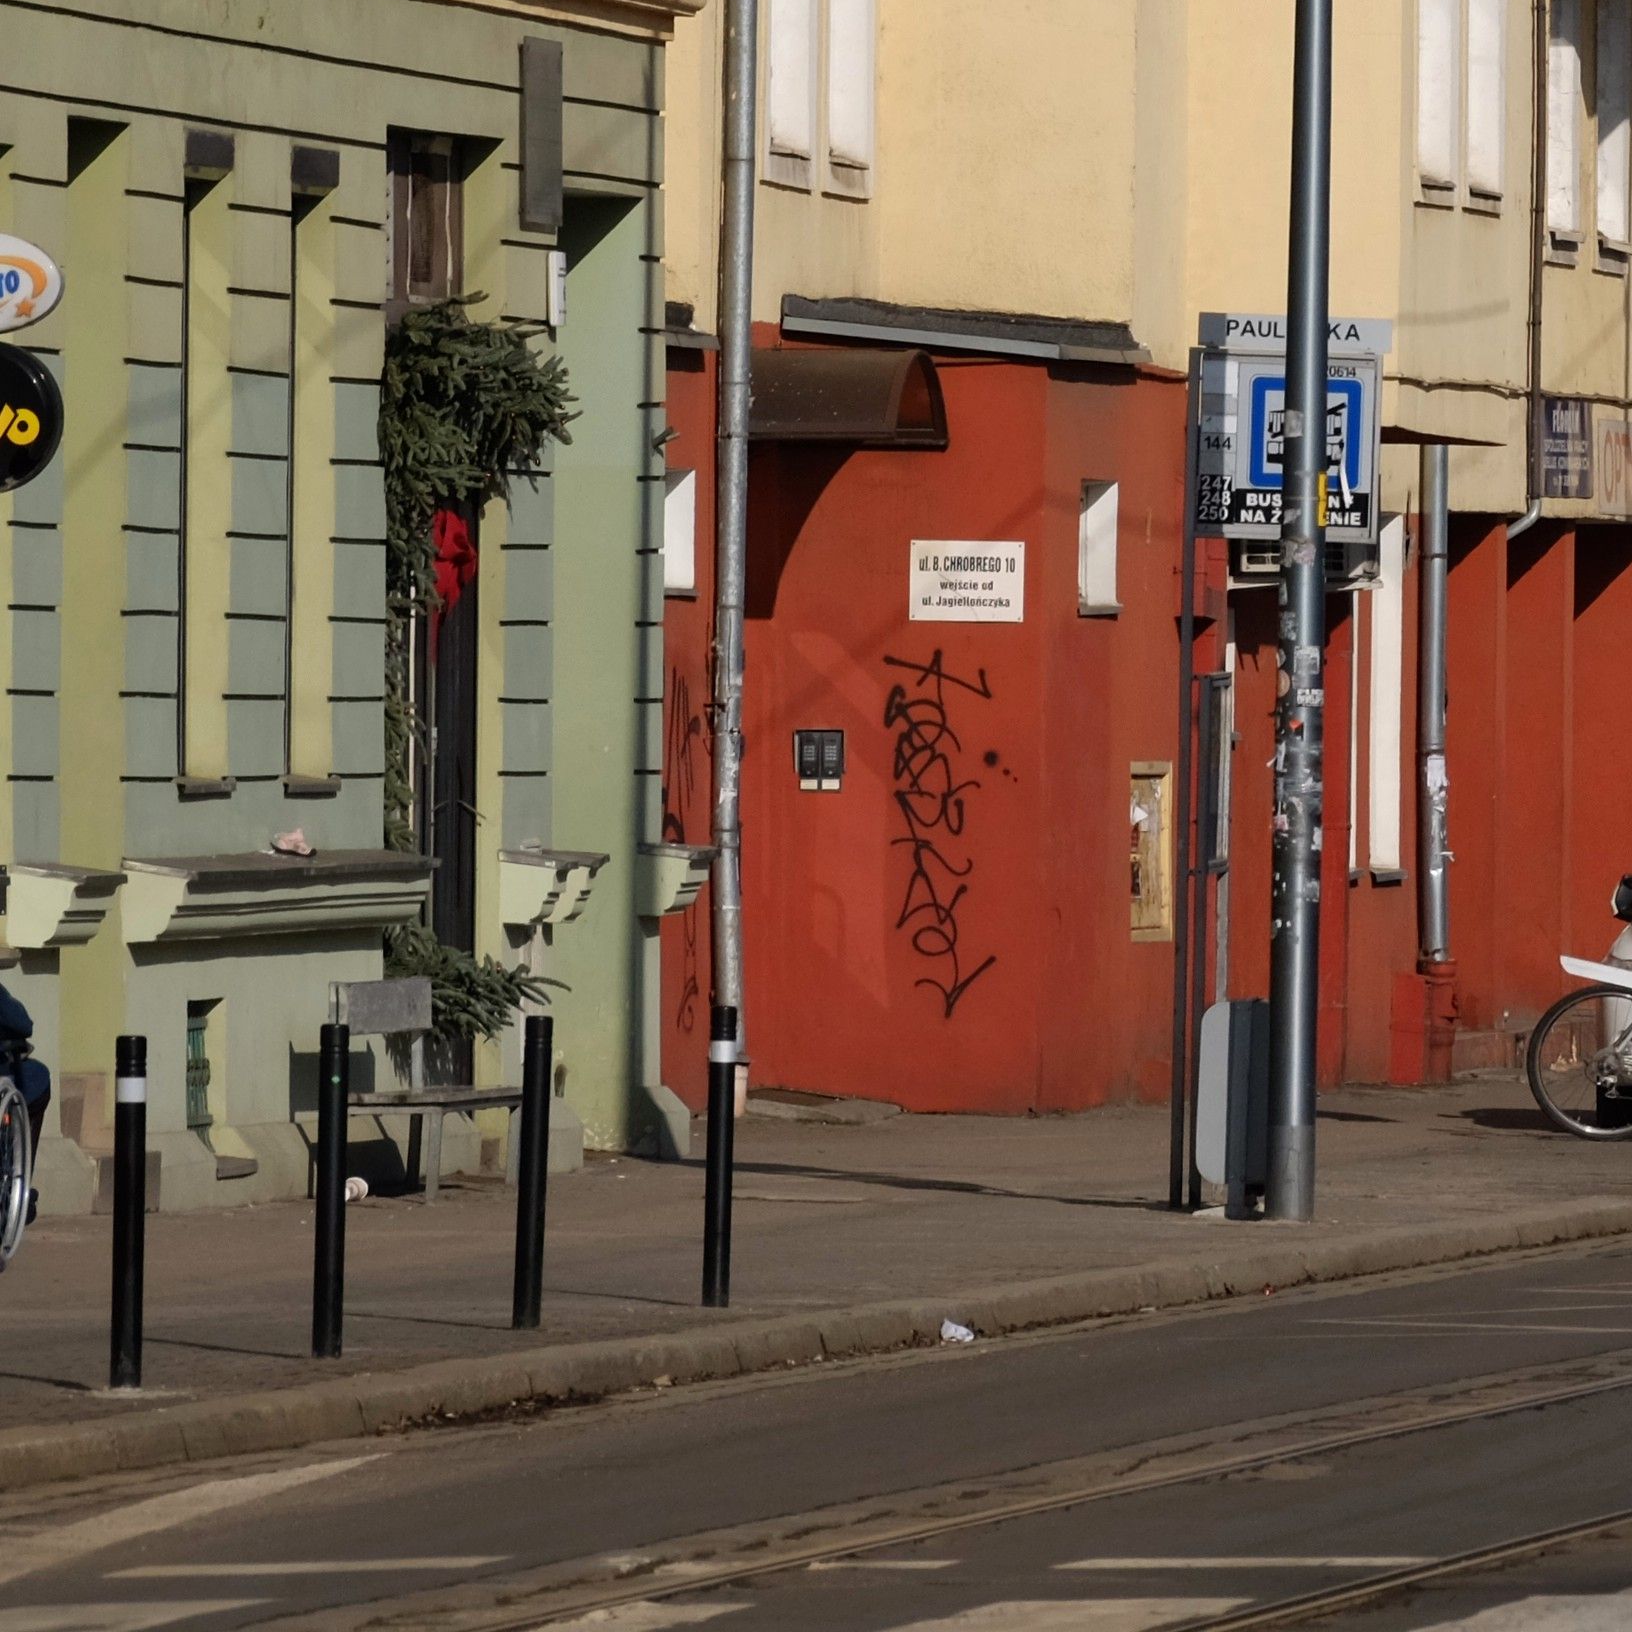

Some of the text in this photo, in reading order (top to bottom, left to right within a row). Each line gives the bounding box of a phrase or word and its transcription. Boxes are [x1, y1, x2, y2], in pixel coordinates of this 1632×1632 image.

[1203, 435, 1232, 451] 144
[1200, 475, 1232, 491] 247
[1201, 490, 1231, 506] 248
[1246, 492, 1283, 507] BUS
[1199, 505, 1229, 521] 250
[1240, 509, 1266, 523] NA
[919, 556, 1016, 573] ul. B. CHROBREGO 10
[940, 579, 994, 592] wejście od
[922, 596, 1011, 609] ul. Jagiellończyka
